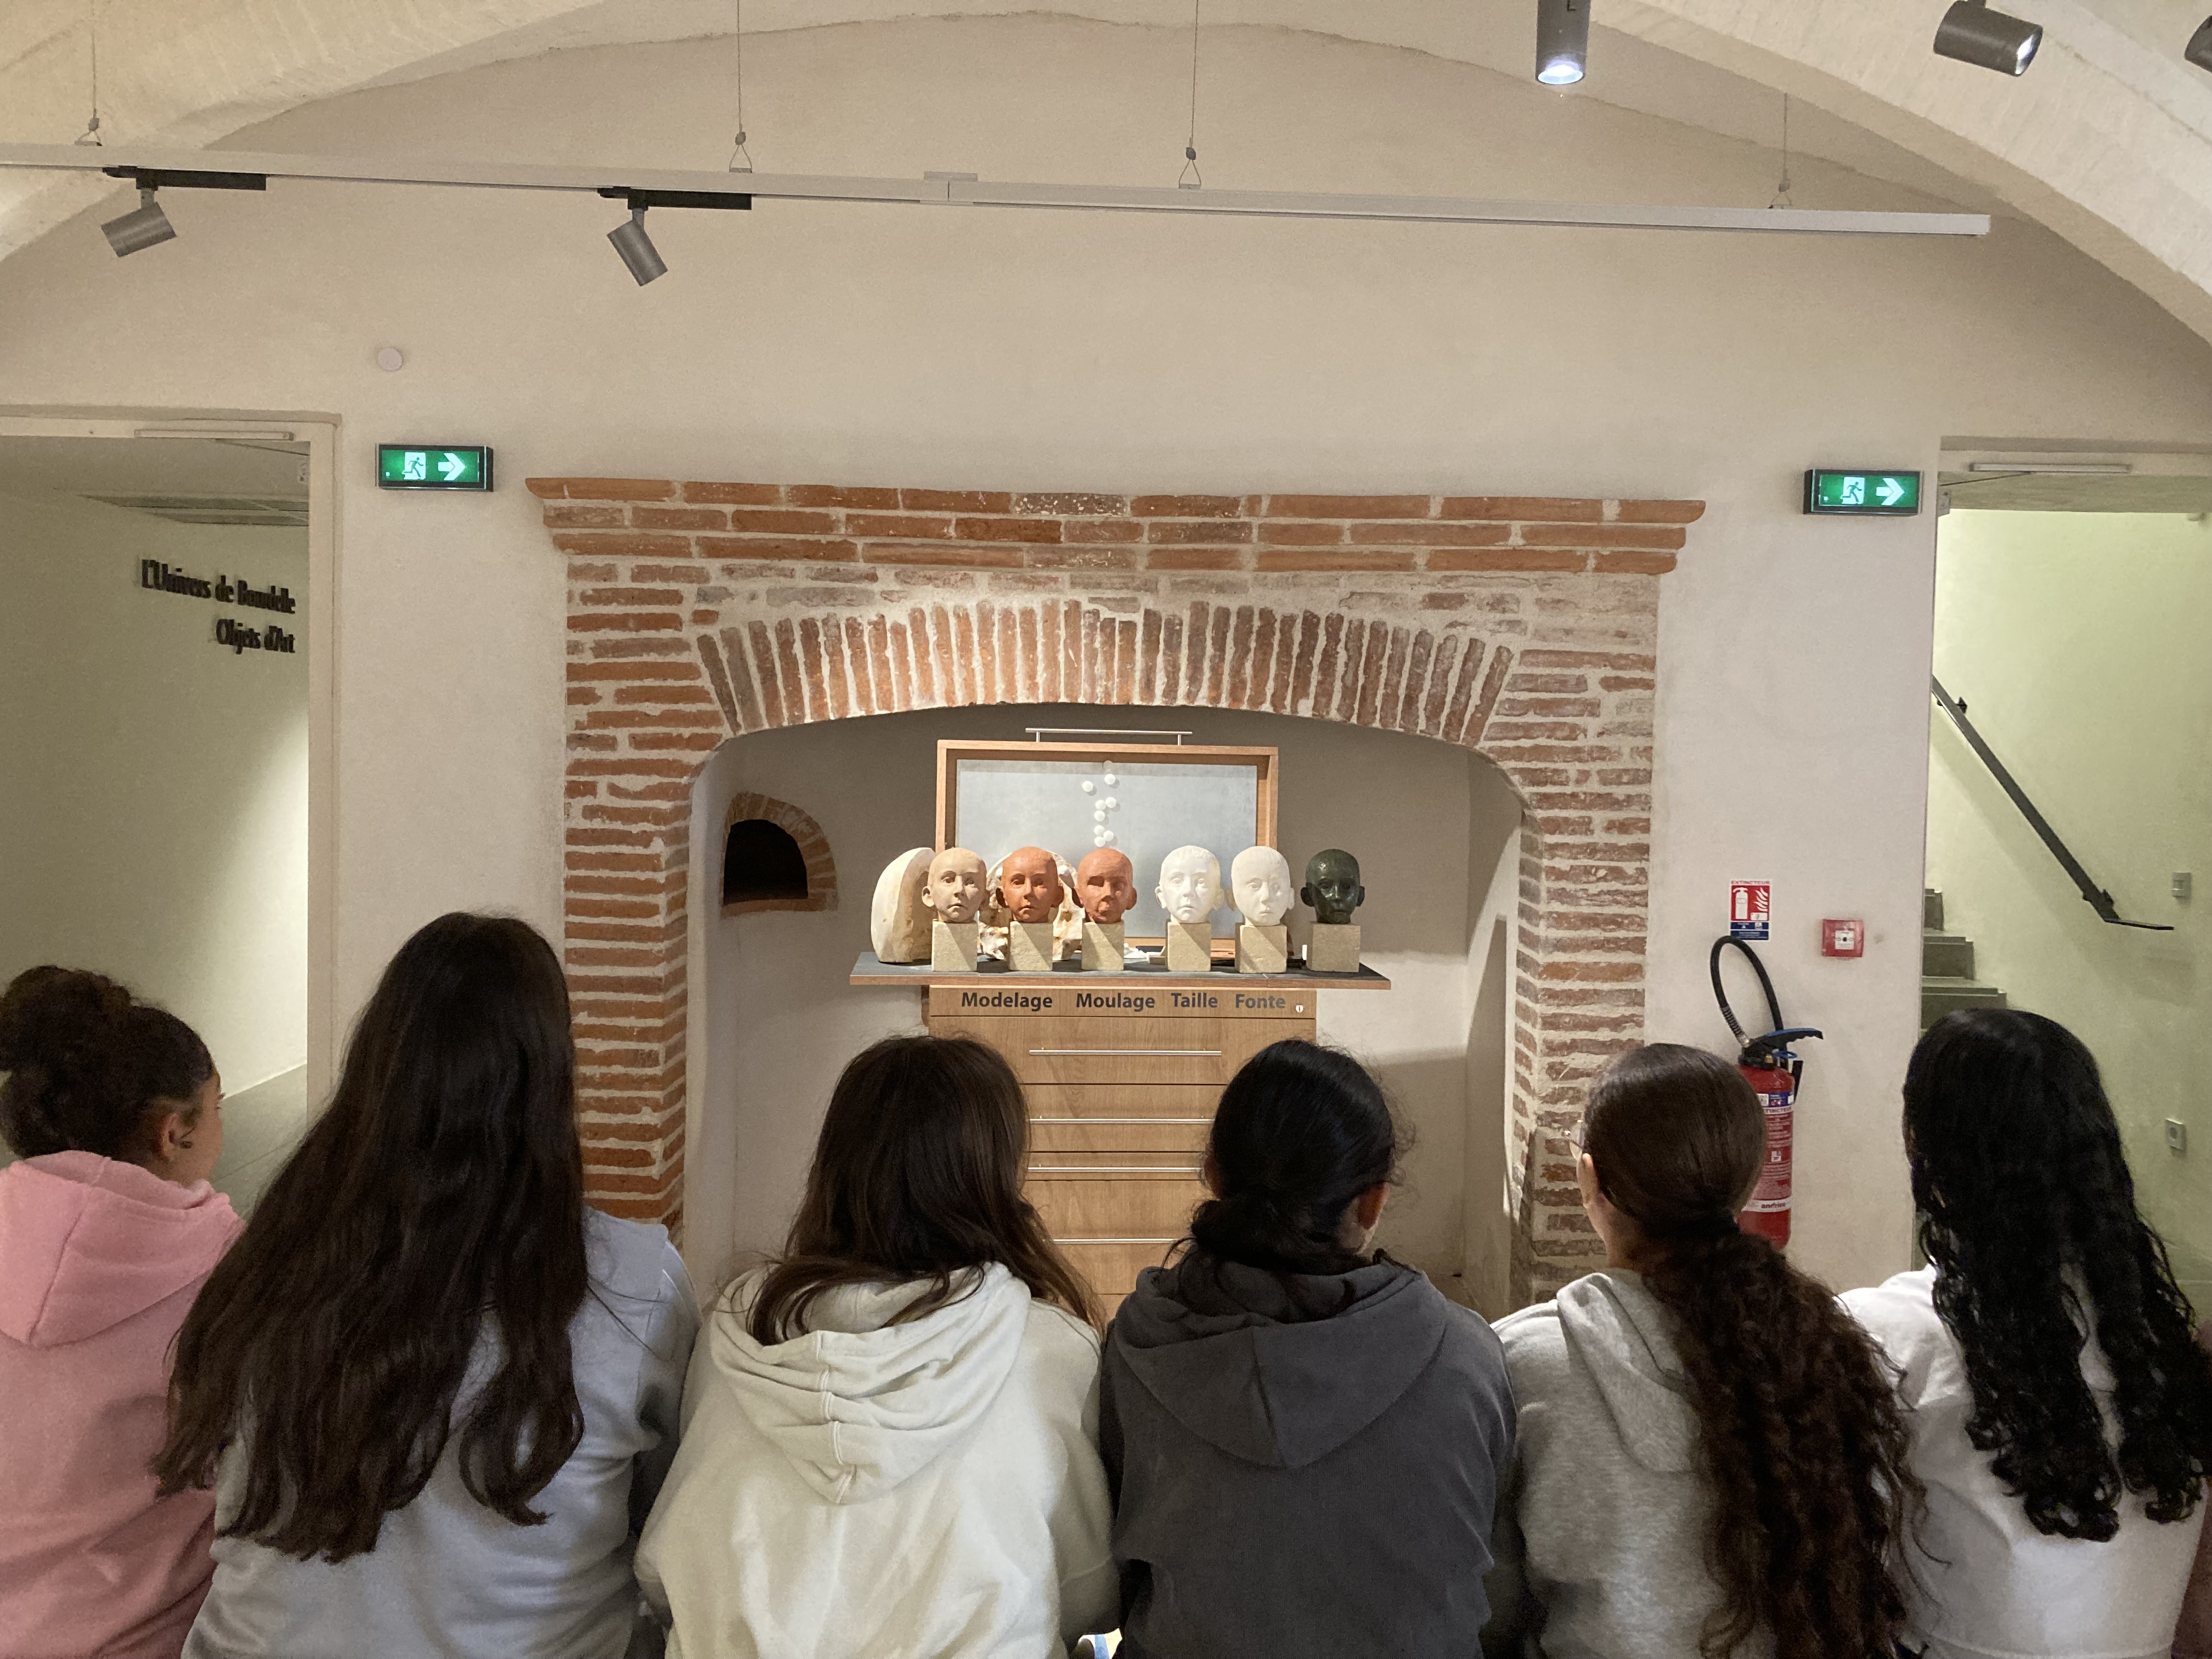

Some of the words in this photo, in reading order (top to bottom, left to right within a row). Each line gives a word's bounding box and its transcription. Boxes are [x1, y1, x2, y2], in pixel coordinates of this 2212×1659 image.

[215, 575, 234, 603] de
[216, 618, 261, 654] Objets
[961, 991, 1053, 1012] Modelage
[1076, 992, 1155, 1013] Moulage
[1171, 992, 1218, 1008] Taille
[1235, 994, 1286, 1009] Fonte
